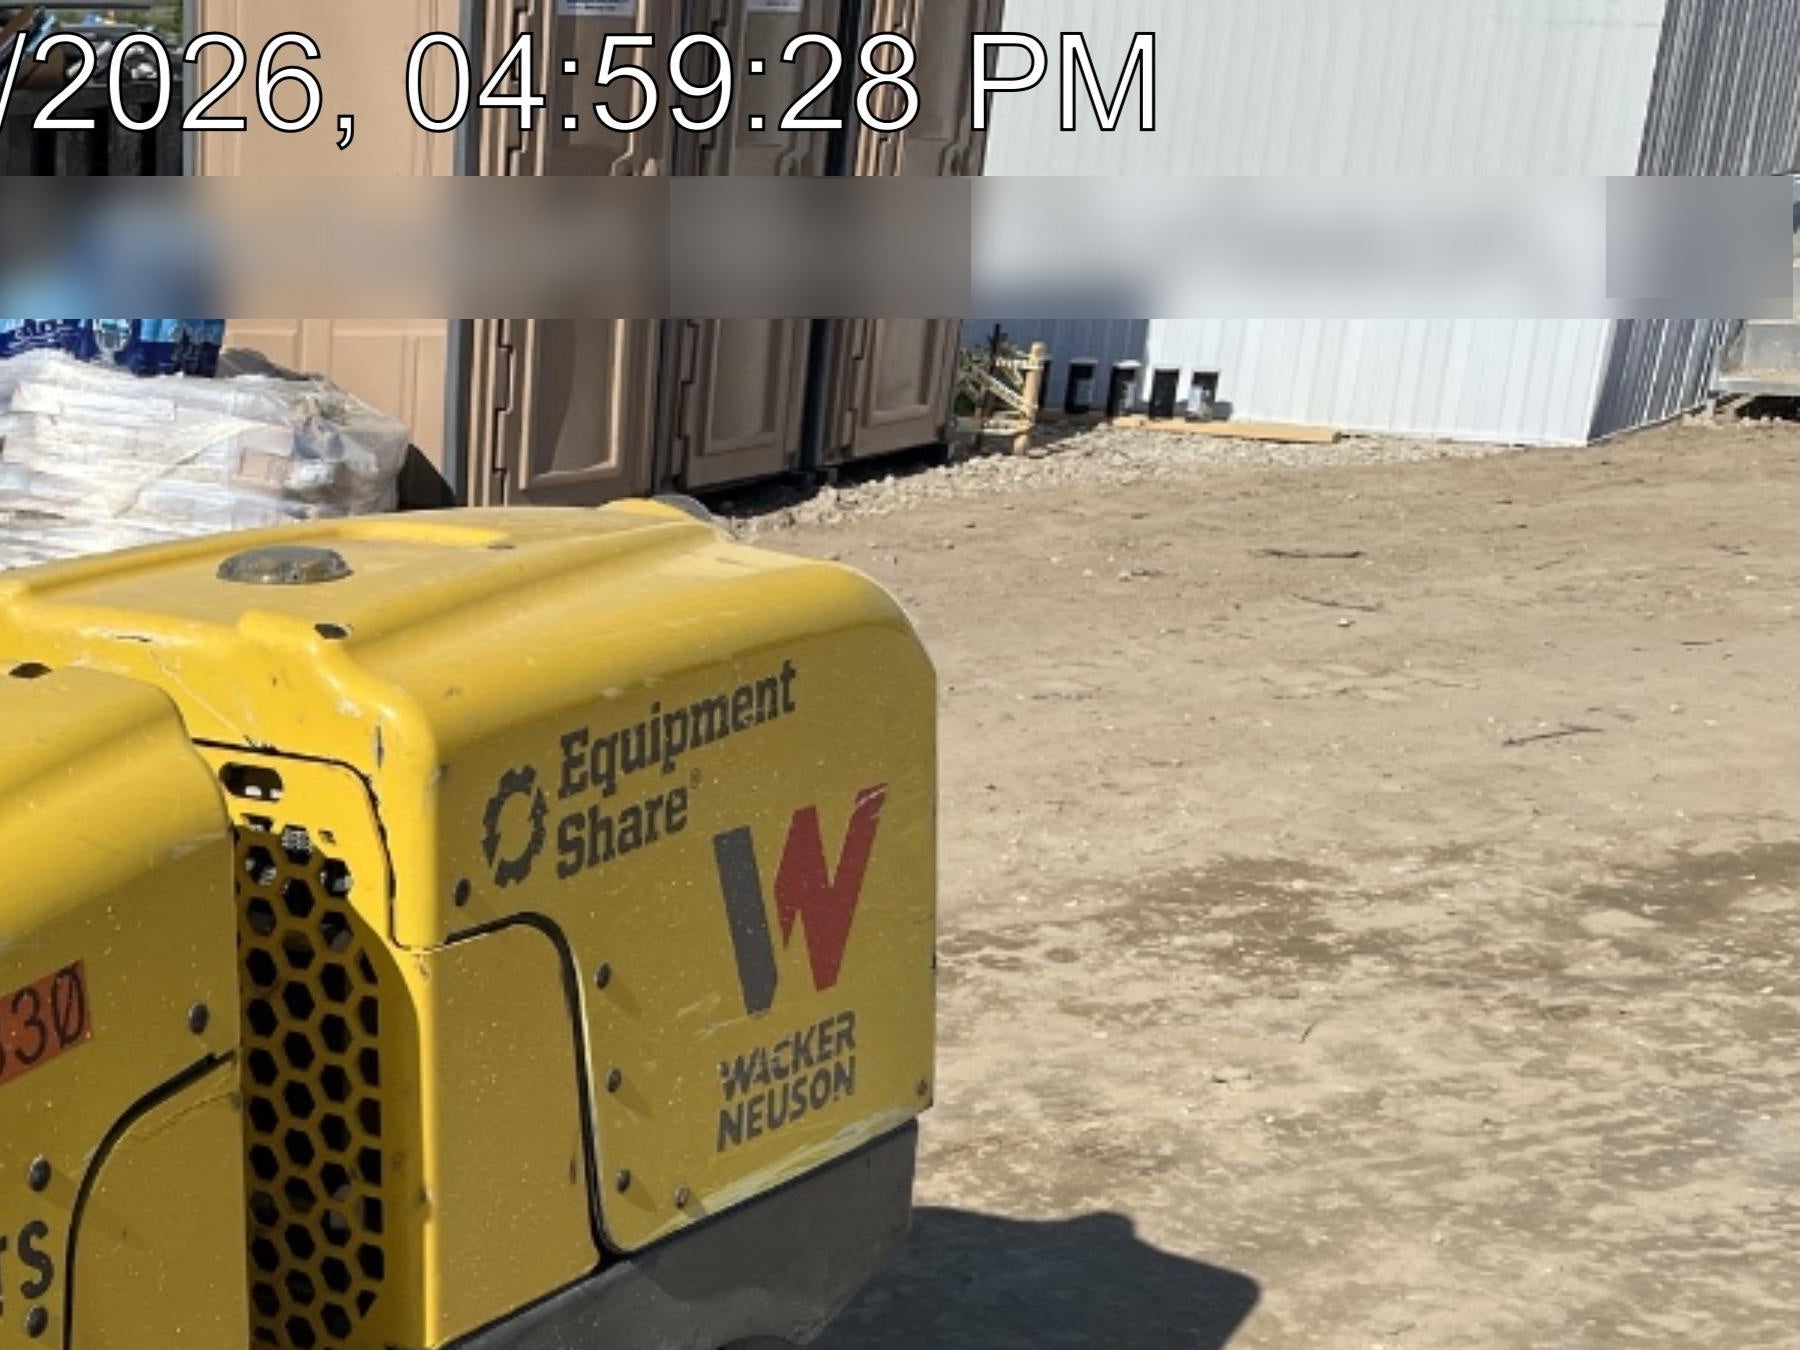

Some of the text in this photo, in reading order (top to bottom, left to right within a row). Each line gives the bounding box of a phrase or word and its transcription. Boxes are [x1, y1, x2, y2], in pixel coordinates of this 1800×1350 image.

[558, 659, 797, 800] Equipment
[557, 786, 688, 880] Share
[717, 1010, 857, 1101] WACKER
[716, 1056, 857, 1153] NEUSON
